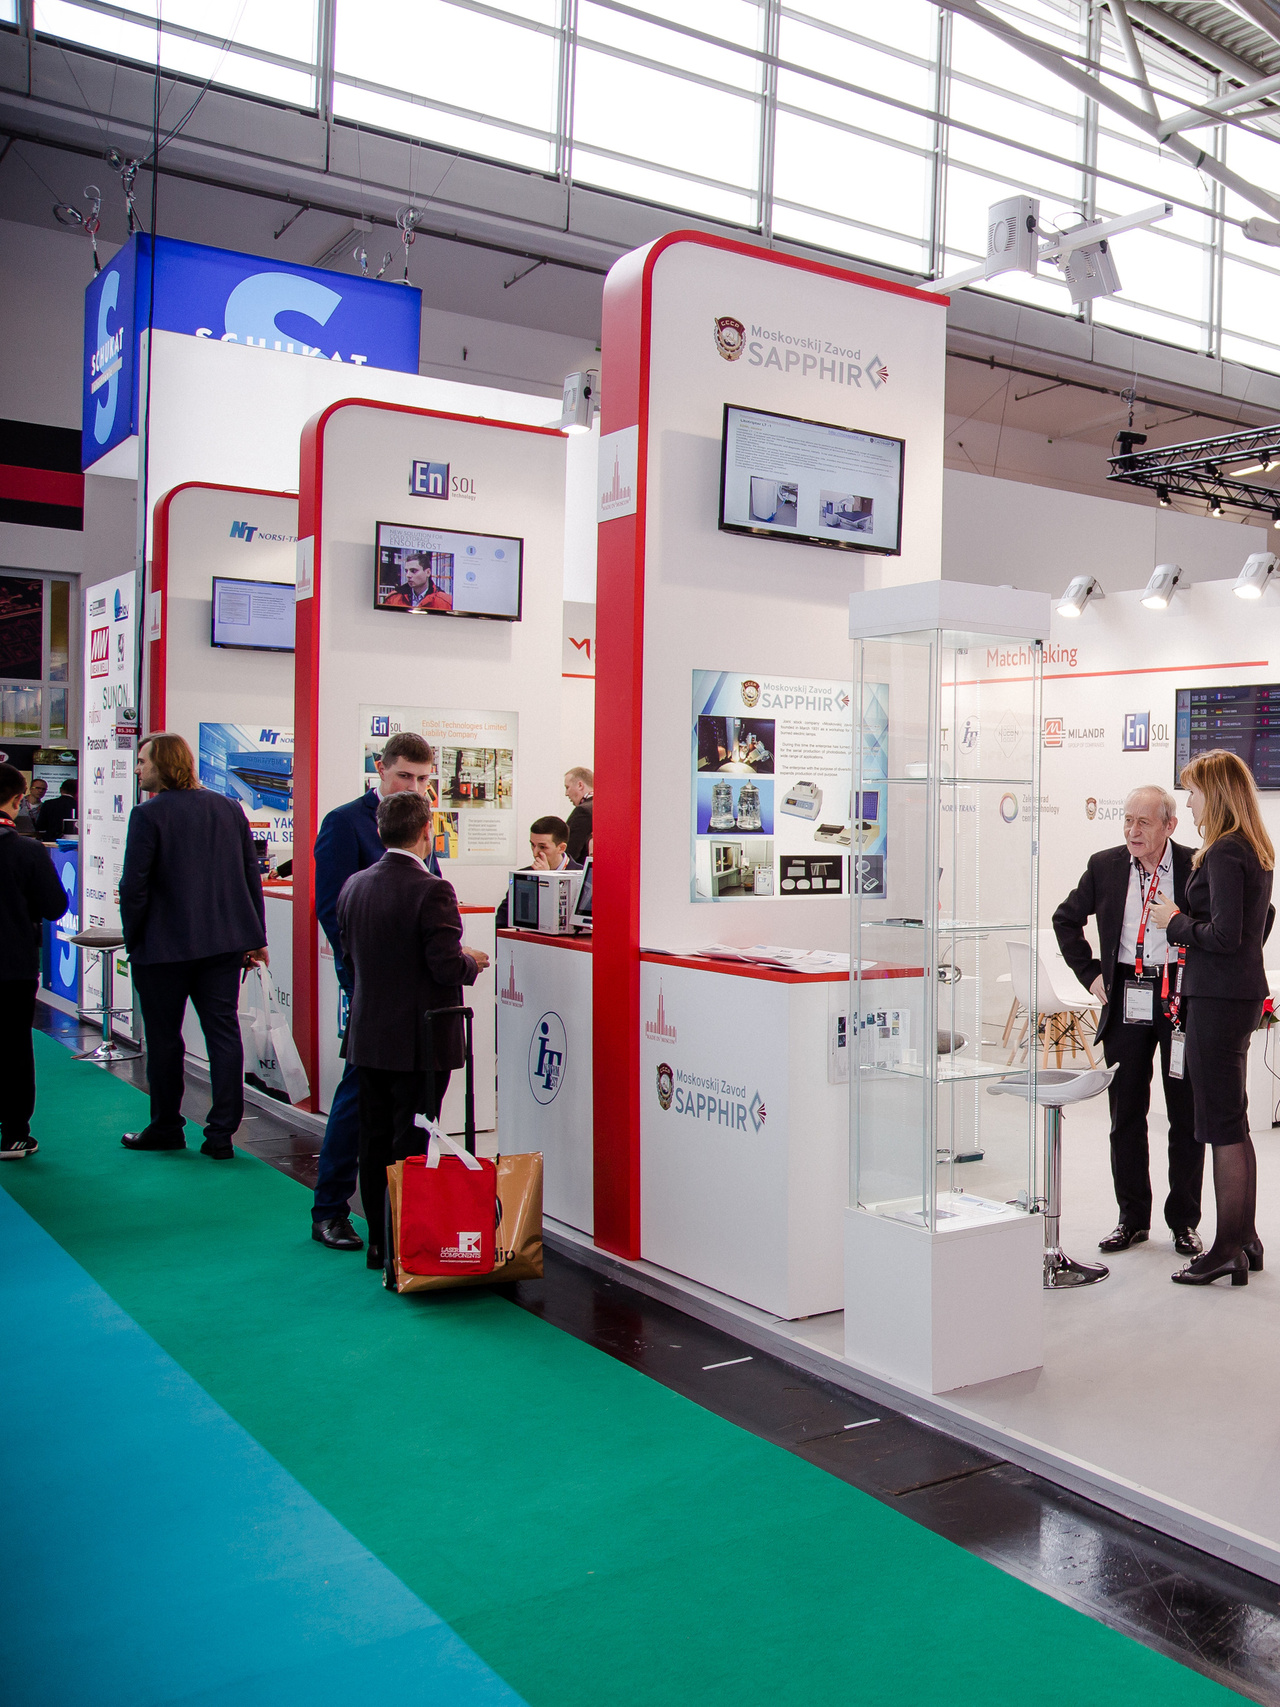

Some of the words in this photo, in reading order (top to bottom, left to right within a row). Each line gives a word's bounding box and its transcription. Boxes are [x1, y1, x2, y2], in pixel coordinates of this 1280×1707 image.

[752, 325, 821, 353] Moskovskij
[825, 342, 860, 360] Zavod
[91, 327, 124, 376] SCHUKAT
[415, 463, 442, 494] En
[452, 477, 476, 494] SOL
[390, 539, 414, 547] ENSOL
[417, 542, 441, 550] FROST
[987, 644, 1077, 667] MatchMaking
[764, 683, 807, 694] Moskovskij
[809, 686, 832, 694] Zavod
[102, 684, 129, 710] SUNON
[373, 717, 386, 733] En
[442, 721, 482, 730] Technologies
[484, 723, 507, 731] Limited
[1127, 716, 1145, 746] En
[1152, 724, 1169, 740] SOL
[422, 730, 446, 738] Liability
[448, 731, 477, 739] Company
[1068, 728, 1104, 738] MILANDR
[87, 735, 108, 750] Panasonic
[1098, 808, 1125, 820] SAPP
[274, 818, 293, 828] YAK
[677, 1069, 720, 1094] Moskovskij
[721, 1081, 745, 1098] Zavod
